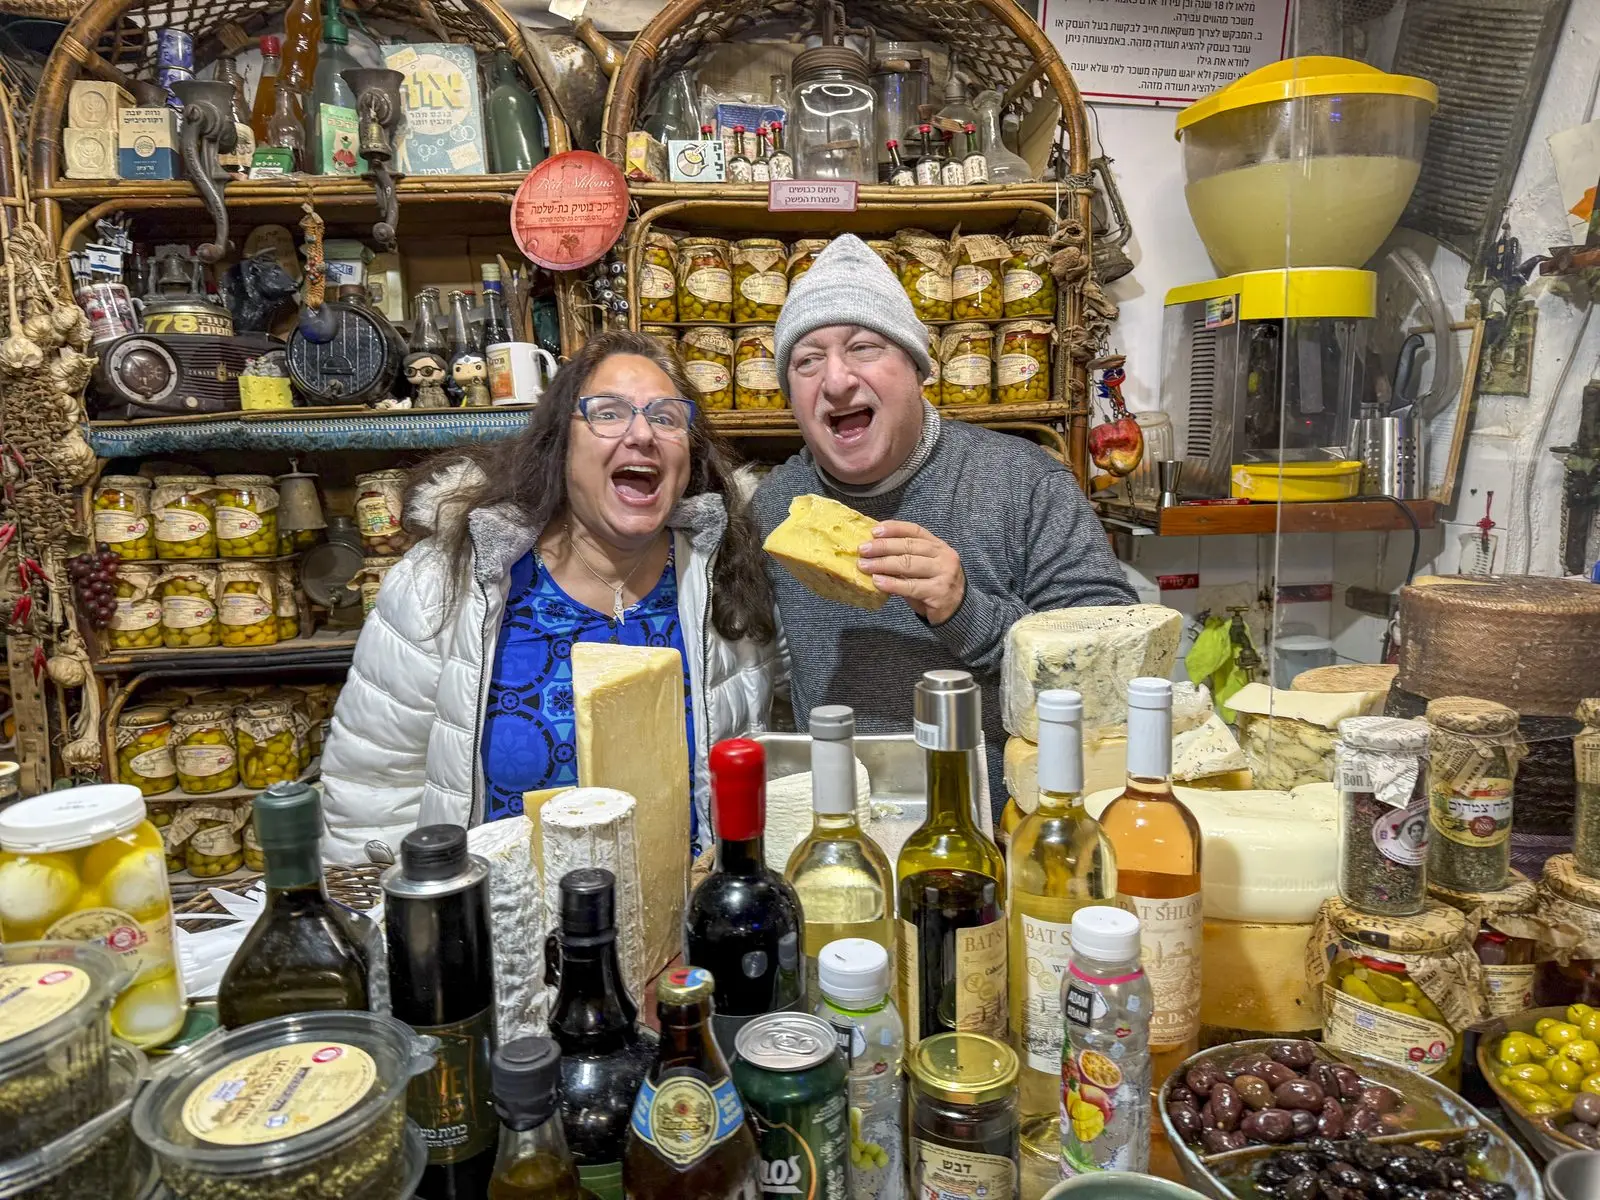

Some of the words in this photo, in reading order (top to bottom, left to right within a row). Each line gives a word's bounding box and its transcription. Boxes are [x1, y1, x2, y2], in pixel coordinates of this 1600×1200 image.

[1195, 0, 1211, 9] שנה
[1215, 1, 1224, 9] 18
[1225, 1, 1234, 10] לו
[1236, 1, 1256, 12] מלאו
[1173, 12, 1201, 22] עבירה.
[1202, 14, 1228, 24] מהווים
[1230, 17, 1254, 26] משכר
[1055, 19, 1064, 27] או
[1065, 19, 1090, 30] העסק
[1091, 20, 1109, 31] בעל
[1110, 23, 1141, 35] לבקשת
[1142, 25, 1159, 34] חייב
[1160, 26, 1195, 38] משקאות
[1197, 28, 1221, 38] לצרוך
[1065, 34, 1081, 45] ניתן
[1082, 35, 1126, 46] באמצעותה
[1222, 30, 1253, 41] המבקש
[1254, 32, 1263, 40] ב.
[1127, 38, 1152, 48] מזהה.
[1153, 39, 1179, 49] תעודה
[1180, 41, 1205, 50] להציג
[1206, 43, 1230, 54] בעסק
[1231, 45, 1251, 54] עובד
[1196, 55, 1212, 66] גילו
[1213, 57, 1226, 66] את
[1227, 58, 1250, 67] לוודא
[1070, 62, 1088, 71] יענה
[1090, 62, 1108, 73] שלא
[1110, 63, 1124, 74] למי
[1126, 65, 1150, 76] משכר
[1151, 67, 1177, 78] משקה
[1178, 69, 1196, 78] יוגש
[1197, 70, 1212, 80] ולא
[1212, 71, 1236, 81] יסופק
[1138, 80, 1163, 90] מזהה.
[1164, 82, 1190, 91] תעודה
[1191, 83, 1216, 93] להציג
[530, 203, 569, 215] בת-שלמה
[571, 203, 594, 215] בוטיק
[1343, 772, 1364, 787] Bon
[1025, 923, 1056, 945] BAT
[1068, 990, 1090, 1009] ADAM
[1067, 1004, 1088, 1023] ADAM
[1168, 1012, 1185, 1025] De
[942, 1159, 972, 1174] דבש
